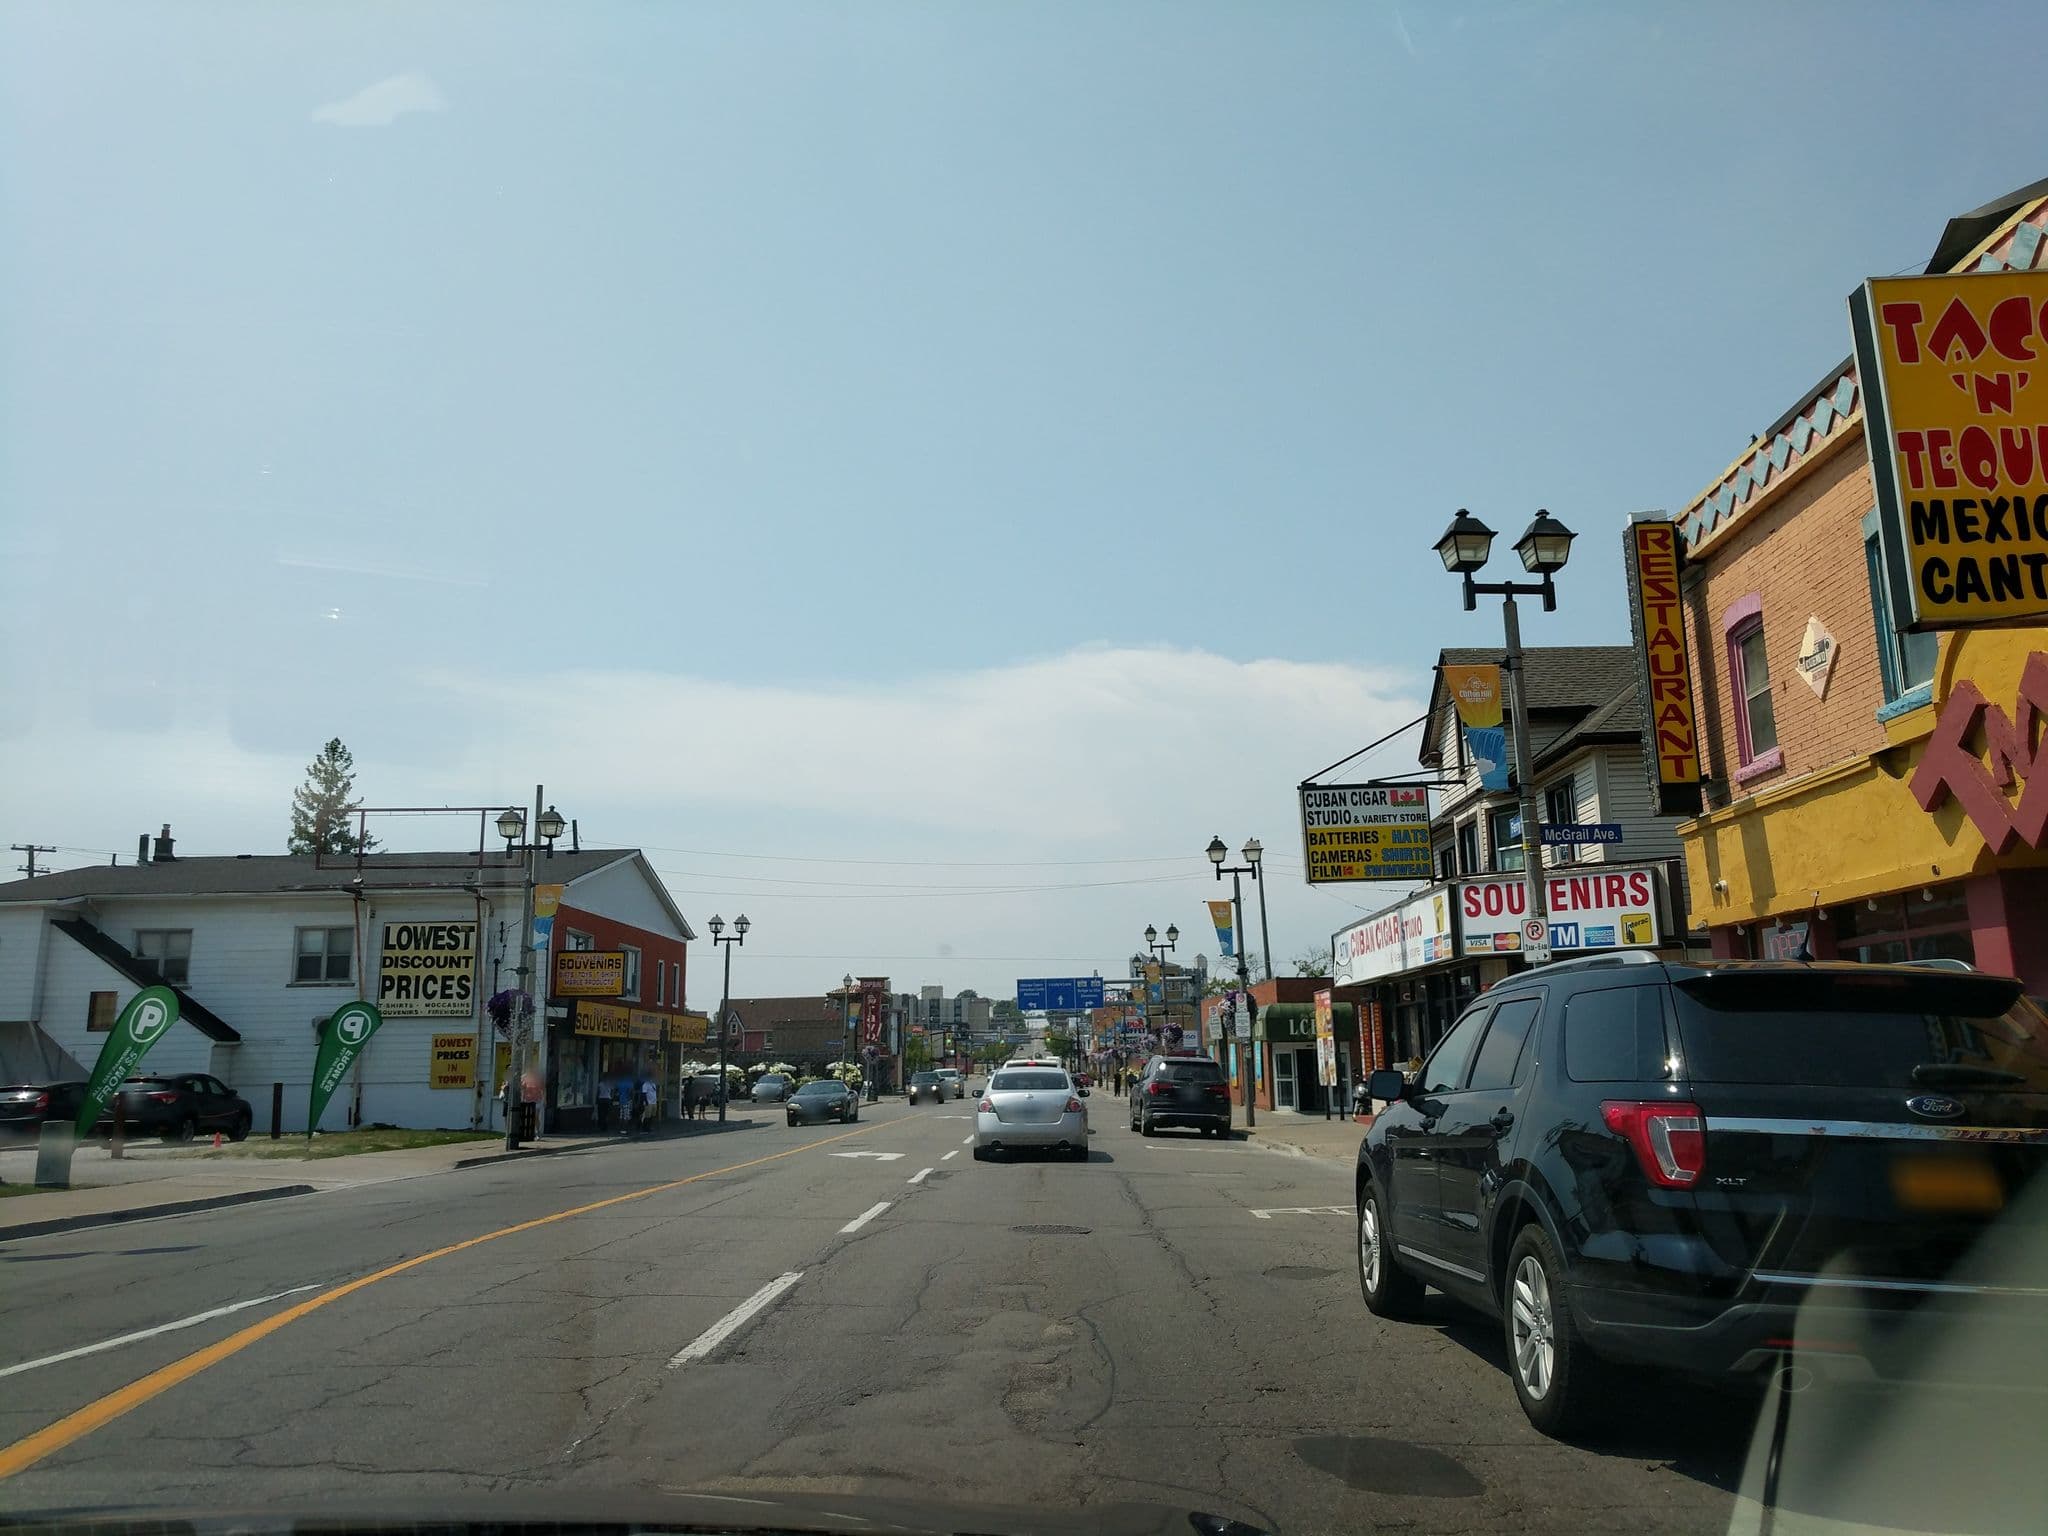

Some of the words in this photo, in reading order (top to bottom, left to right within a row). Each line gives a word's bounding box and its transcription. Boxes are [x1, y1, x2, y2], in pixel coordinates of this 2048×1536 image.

[1882, 297, 2048, 363] TAC
[1638, 529, 1694, 778] RESTAURANT
[1306, 791, 1347, 808] CUBAN
[1350, 790, 1387, 806] CIGAR
[1307, 810, 1351, 826] STUDIO
[1362, 814, 1398, 823] VARIETY
[1400, 813, 1427, 822] STORE
[1309, 831, 1379, 845] BATTERIES
[1392, 829, 1429, 843] HATS
[1544, 828, 1589, 841] McGrail
[1593, 828, 1618, 840] Ave.
[1311, 849, 1372, 864] CAMERAS
[1382, 847, 1430, 861] SHIRTS
[1312, 866, 1342, 877] FILM
[1364, 863, 1431, 876] SWIMWEAR
[1464, 872, 1649, 917] SOUENIRS
[1625, 917, 1649, 931] Interac
[384, 925, 475, 950] LOWEST
[1350, 925, 1375, 958] CUBAN
[1375, 916, 1400, 949] CIGAR
[1469, 939, 1487, 947] VISA
[382, 956, 473, 968] DISCOUNT
[560, 958, 621, 969] SOUVENIRS
[380, 975, 471, 1000] PRICES
[135, 1005, 163, 1035] P
[575, 1012, 627, 1033] SOUVENIRS
[434, 1038, 473, 1048] LOWEST
[437, 1051, 470, 1060] PRICES
[447, 1063, 458, 1072] IN
[96, 1065, 127, 1103] FROM
[438, 1075, 467, 1084] TOWN
[1921, 1098, 1953, 1112] Ford
[1715, 1177, 1749, 1186] XLT
